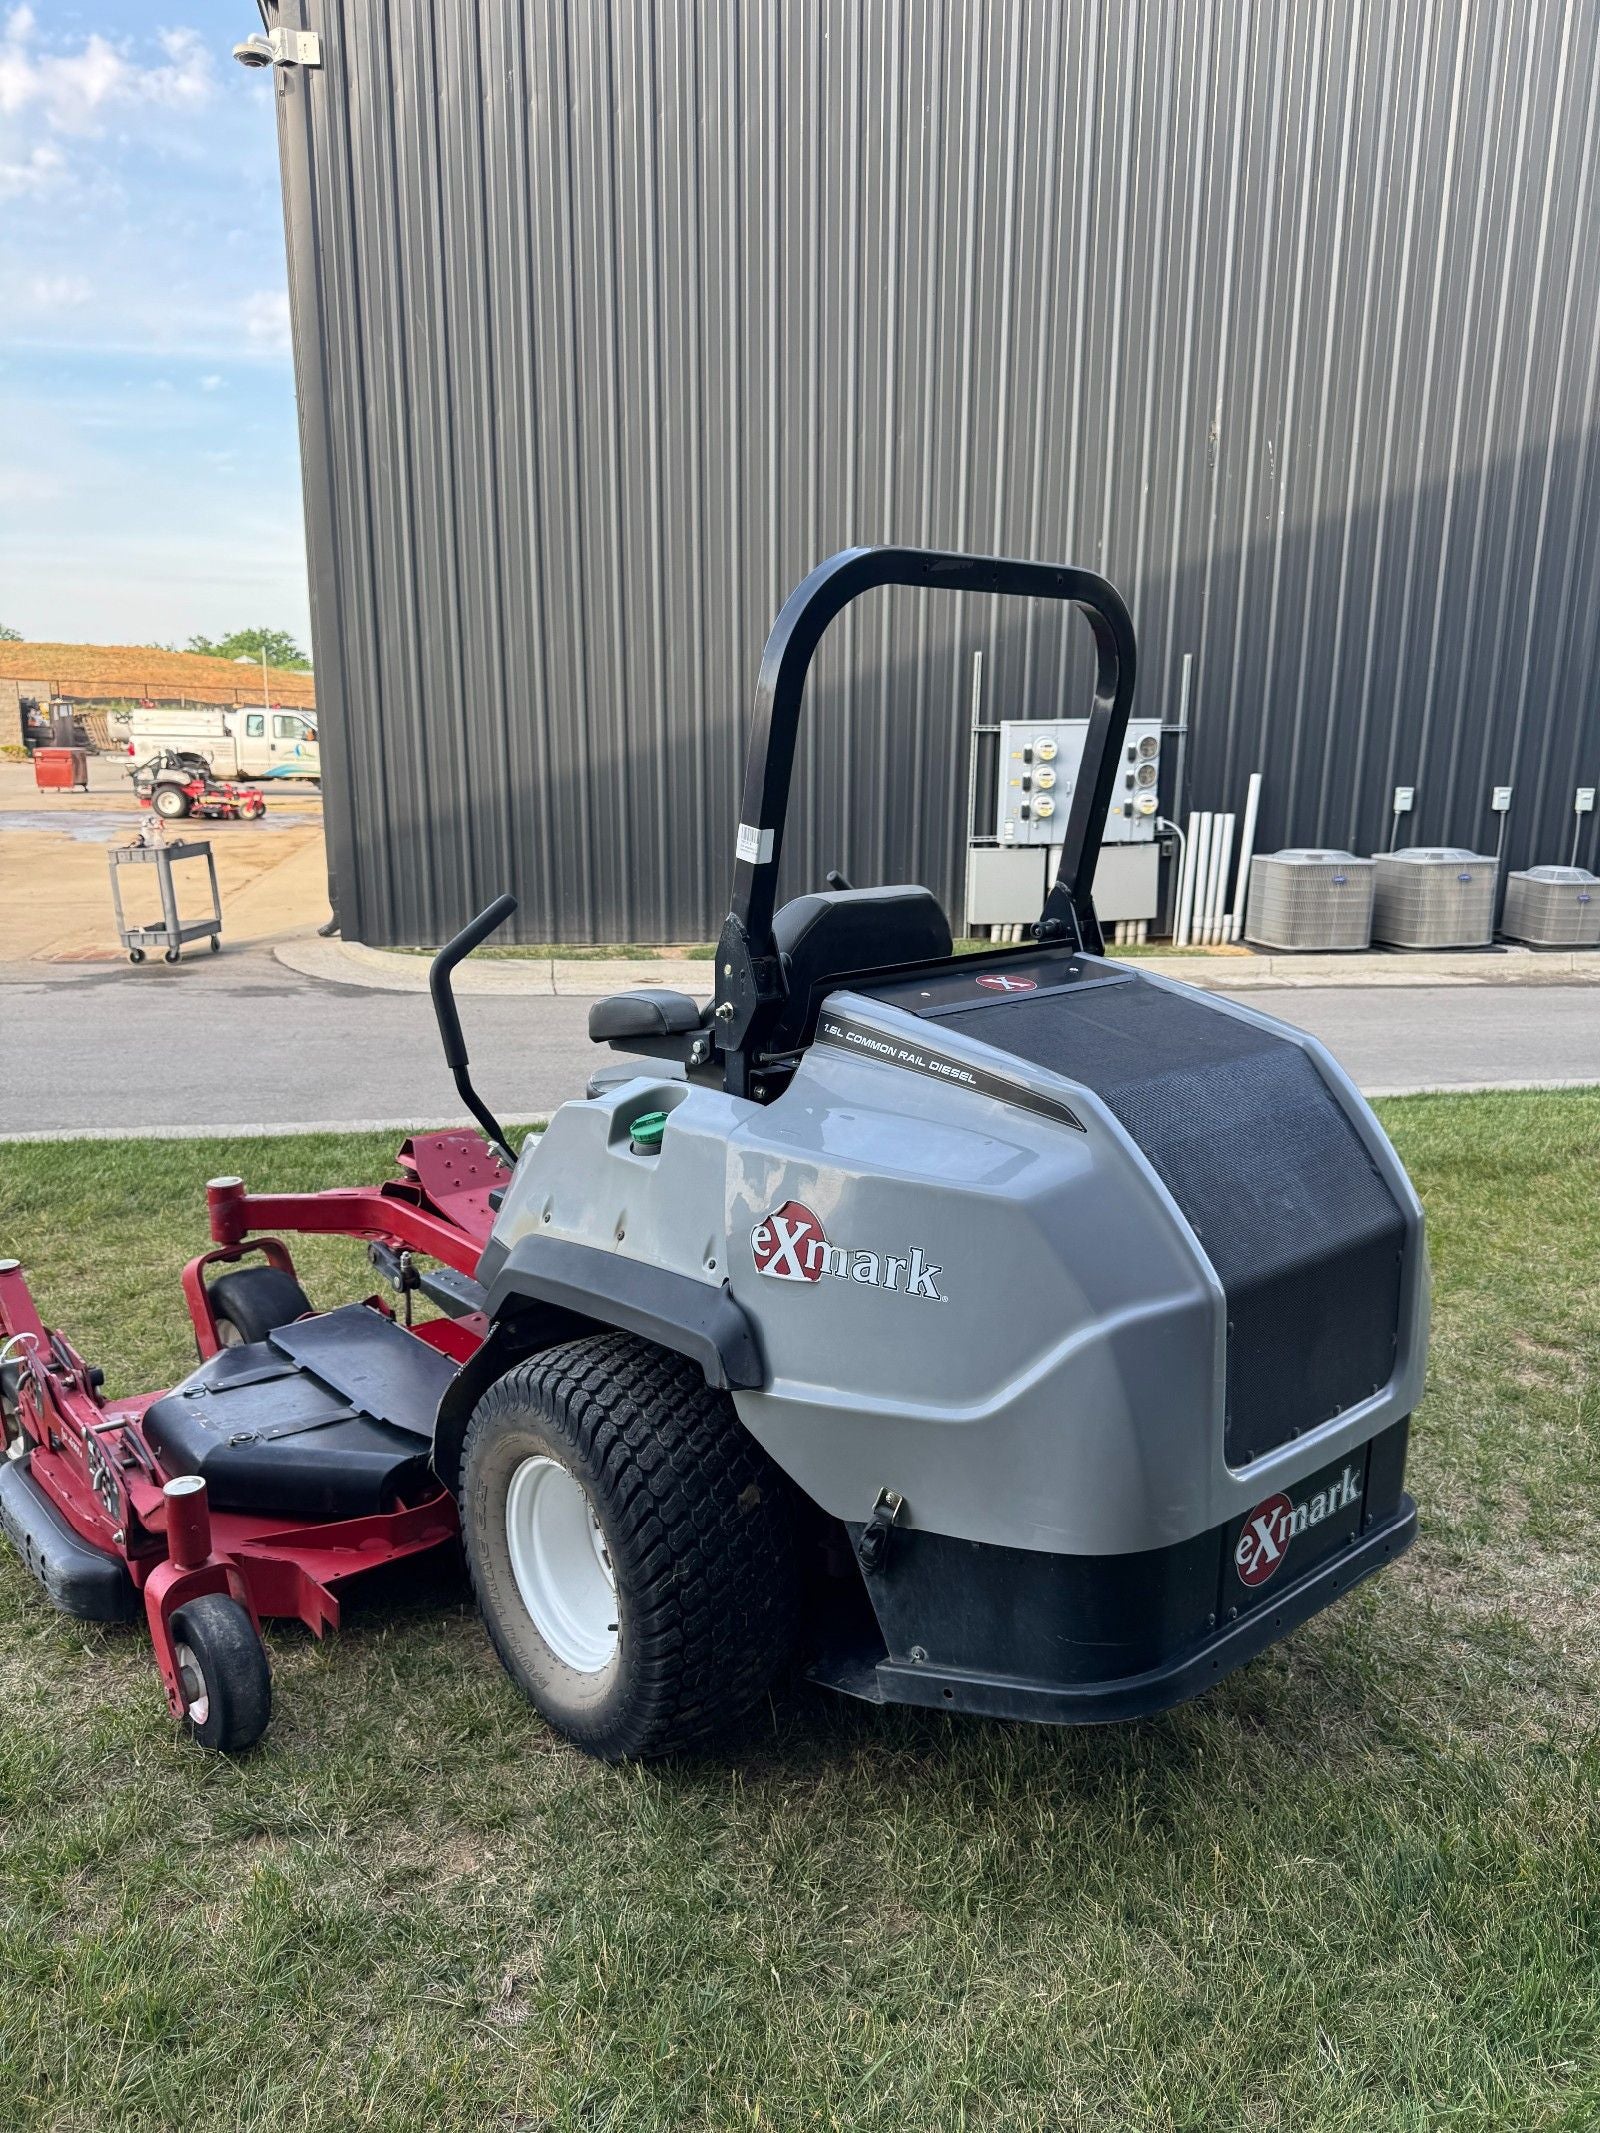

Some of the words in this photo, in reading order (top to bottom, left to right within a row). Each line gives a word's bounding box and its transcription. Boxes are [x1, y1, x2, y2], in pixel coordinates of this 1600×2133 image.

[824, 1023, 844, 1038] 1.6L
[845, 1031, 898, 1057] COMMON
[898, 1050, 926, 1067] RAIL
[928, 1060, 977, 1084] DIESEL
